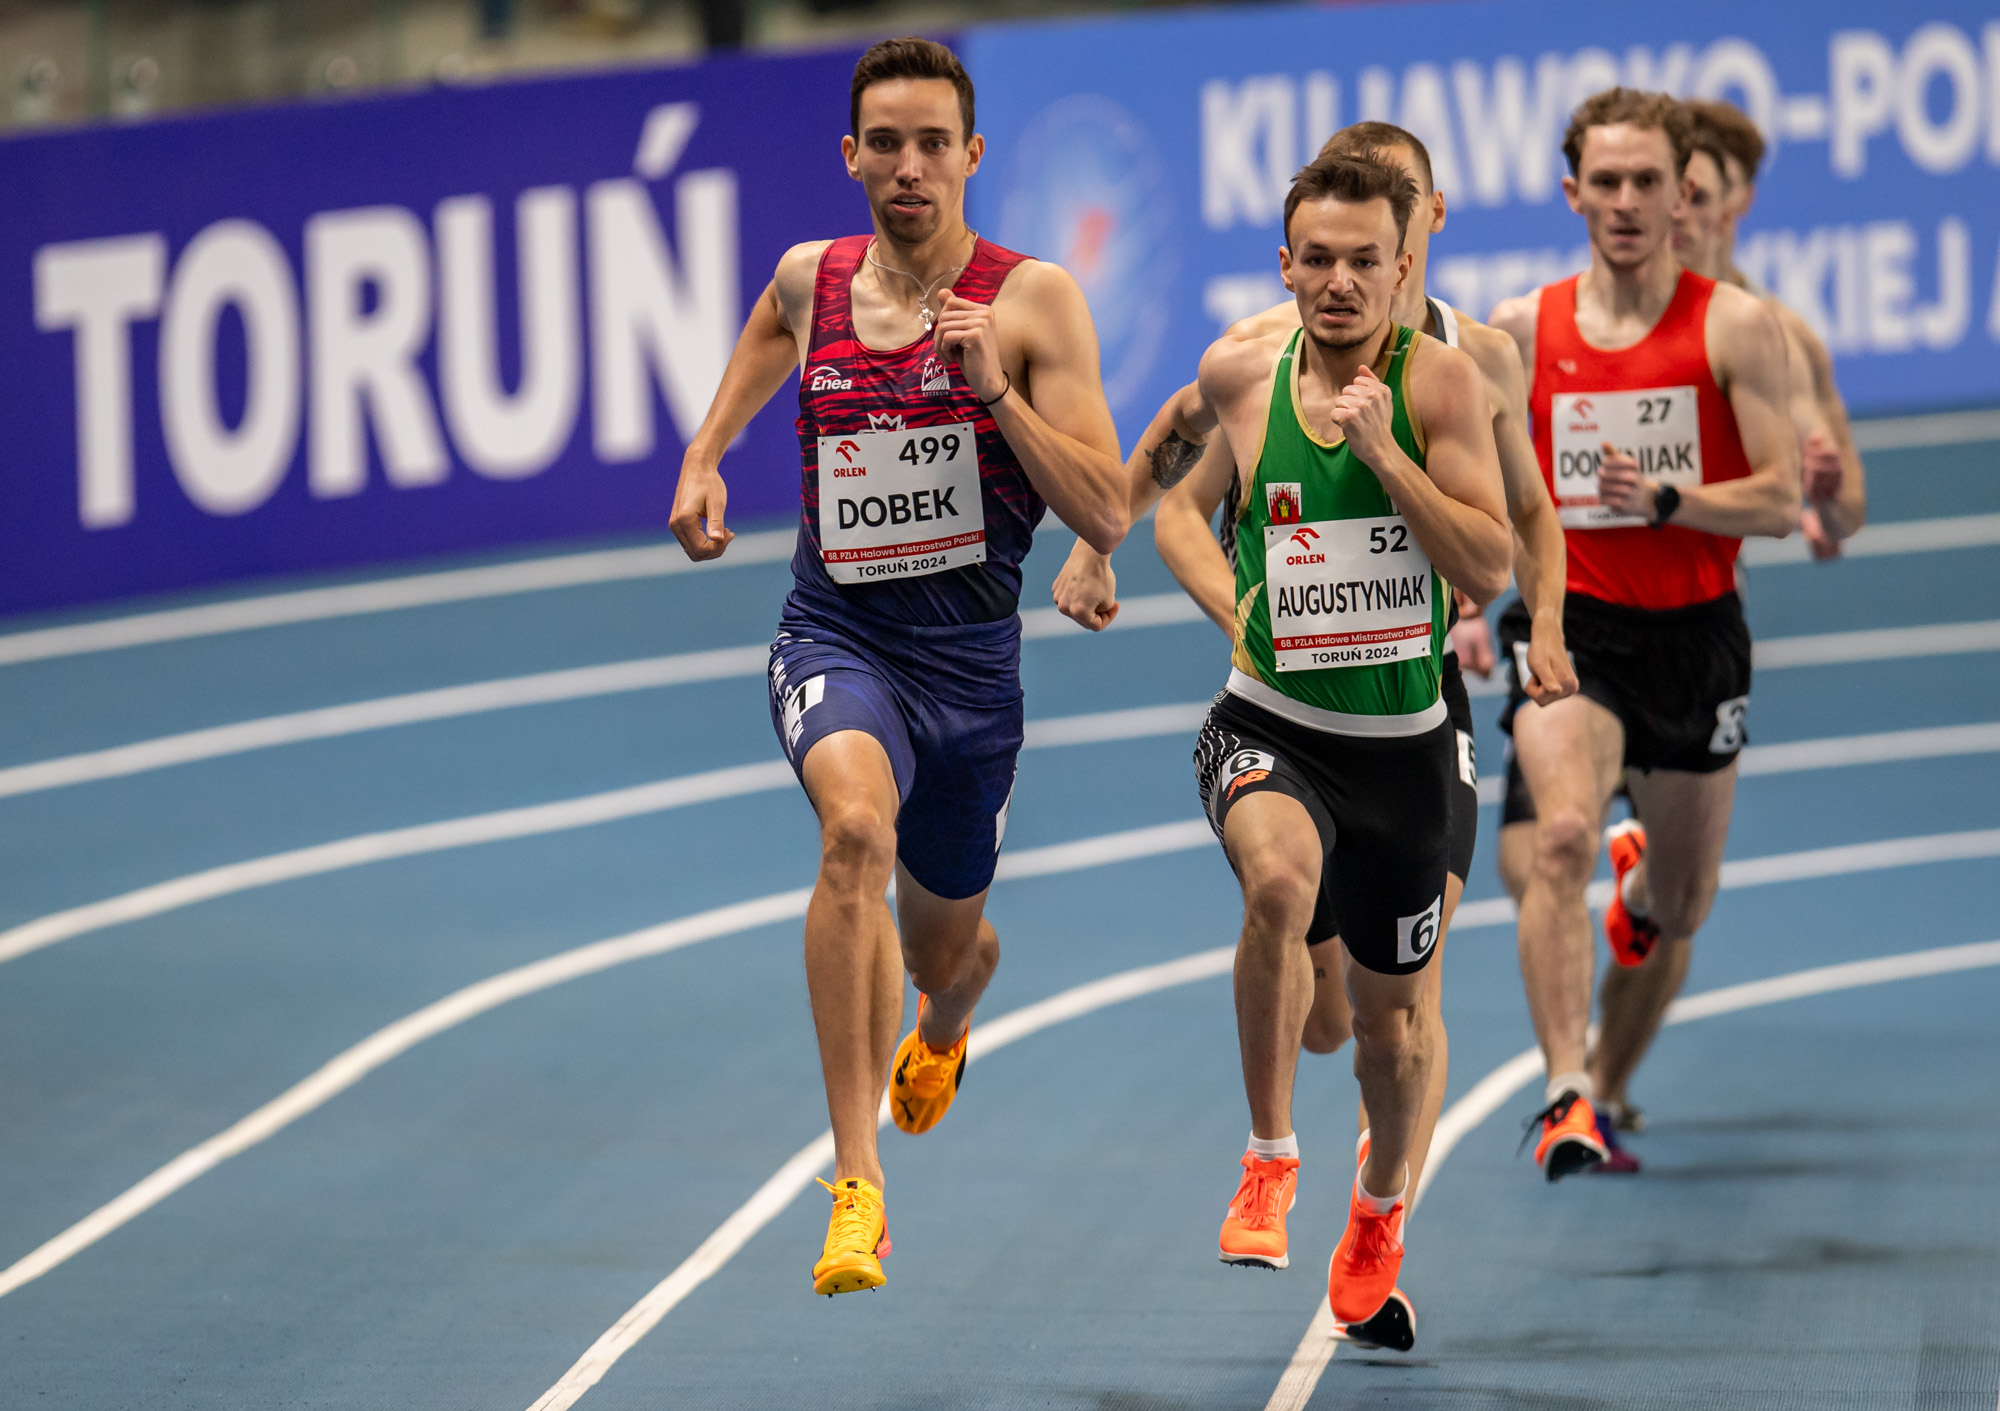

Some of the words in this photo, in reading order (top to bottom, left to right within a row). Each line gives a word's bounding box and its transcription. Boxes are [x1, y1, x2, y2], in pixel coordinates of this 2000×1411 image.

[31, 100, 744, 531] TORUŃ
[811, 375, 853, 391] Enea
[1637, 397, 1672, 425] 27
[898, 433, 960, 466] 499
[833, 466, 867, 478] ORLEN
[837, 486, 960, 530] DOBEK
[828, 551, 840, 561] 68.
[840, 550, 859, 561] PZLA
[860, 547, 895, 558] Halowe
[897, 538, 952, 555] Mistrzostwa
[953, 532, 980, 545] Polski
[1369, 525, 1409, 554] 52
[856, 559, 909, 578] TORUŃ
[912, 555, 947, 572] 2024
[1286, 553, 1325, 566] ORLEN
[1277, 574, 1426, 618] AUGUSTYNIAK
[1280, 639, 1294, 648] 68.
[1294, 637, 1314, 647] PZLA
[1315, 635, 1350, 646] Halowe
[1351, 629, 1404, 643] Mistrzostwa
[1405, 625, 1426, 636] Polski
[1311, 646, 1362, 664] TORUŃ
[1364, 645, 1399, 661] 2024
[1230, 751, 1260, 774] 6
[1410, 911, 1434, 955] 6
